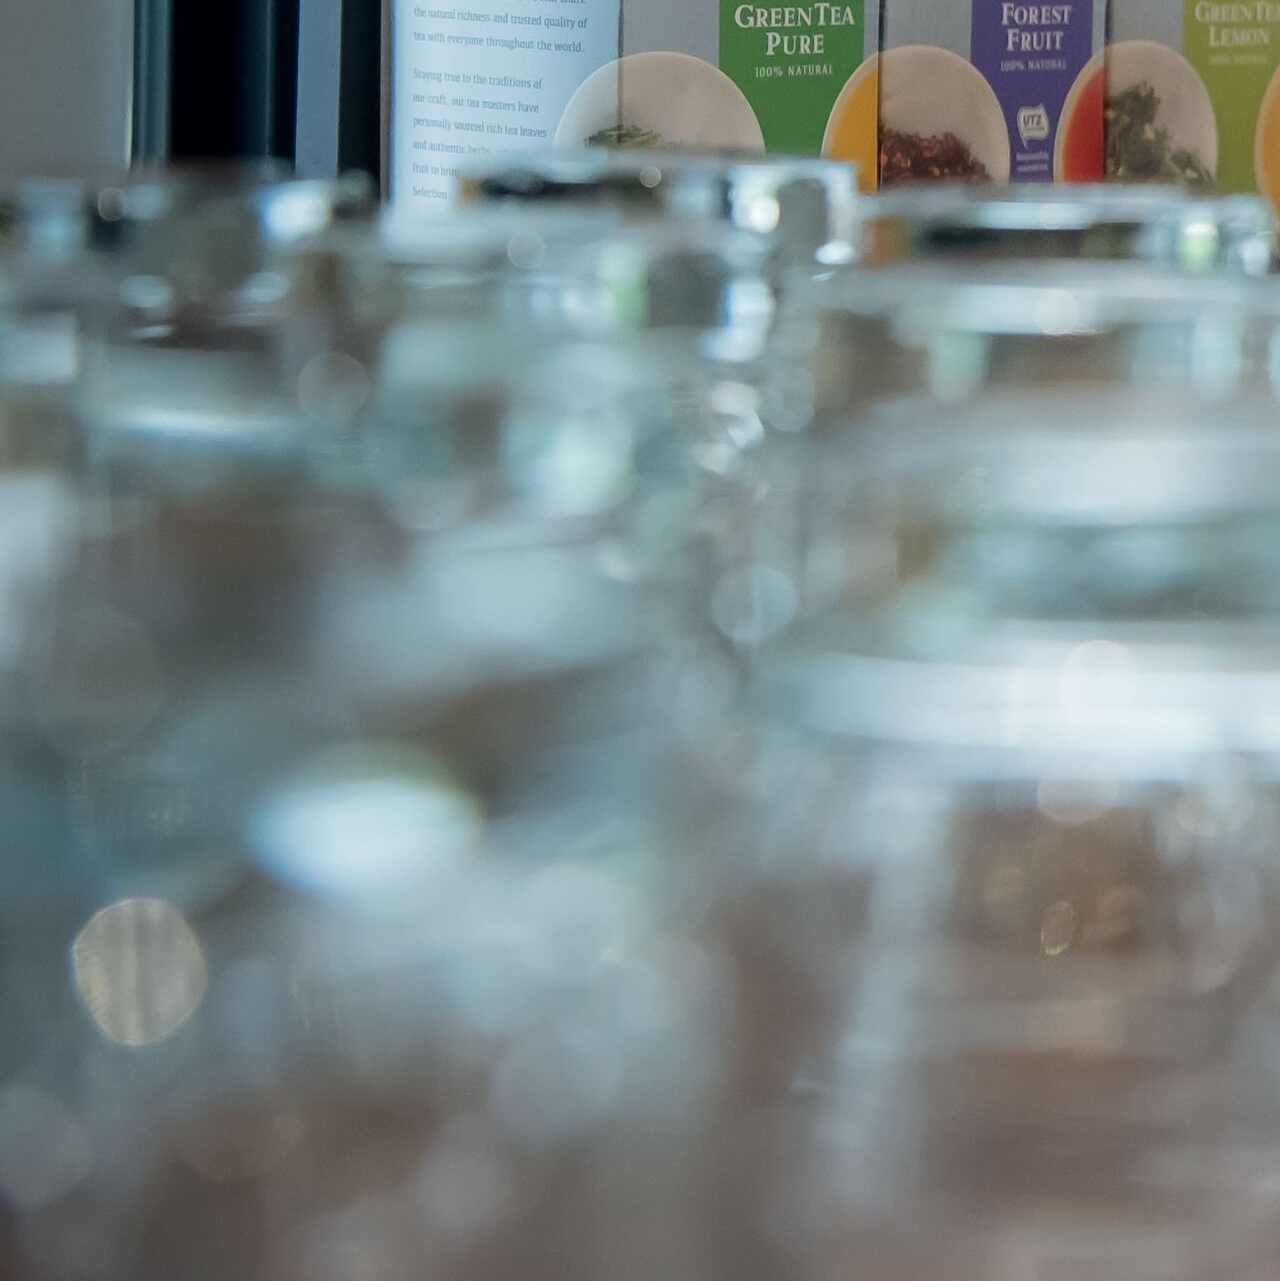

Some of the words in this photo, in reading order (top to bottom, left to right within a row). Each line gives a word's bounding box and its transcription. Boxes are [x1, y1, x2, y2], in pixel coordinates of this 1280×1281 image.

[414, 7, 426, 17] the
[428, 9, 455, 19] natural
[457, 11, 490, 22] richness
[493, 12, 508, 23] and
[511, 14, 541, 26] trusted
[544, 15, 575, 30] quality
[578, 18, 587, 28] of
[735, 4, 812, 28] GREEN
[814, 3, 855, 26] TEA
[1002, 3, 1072, 26] FOREST
[414, 31, 425, 41] tea
[428, 31, 445, 42] with
[447, 35, 484, 46] everyone
[486, 37, 534, 51] throughout
[537, 38, 552, 50] the
[555, 40, 584, 53] world.
[766, 32, 824, 55] PURE
[1007, 29, 1064, 52] FRUIT
[1209, 24, 1269, 47] LEMON
[755, 66, 783, 78] 100%
[788, 64, 832, 76] NATURAL
[1023, 115, 1042, 126] UTZ
